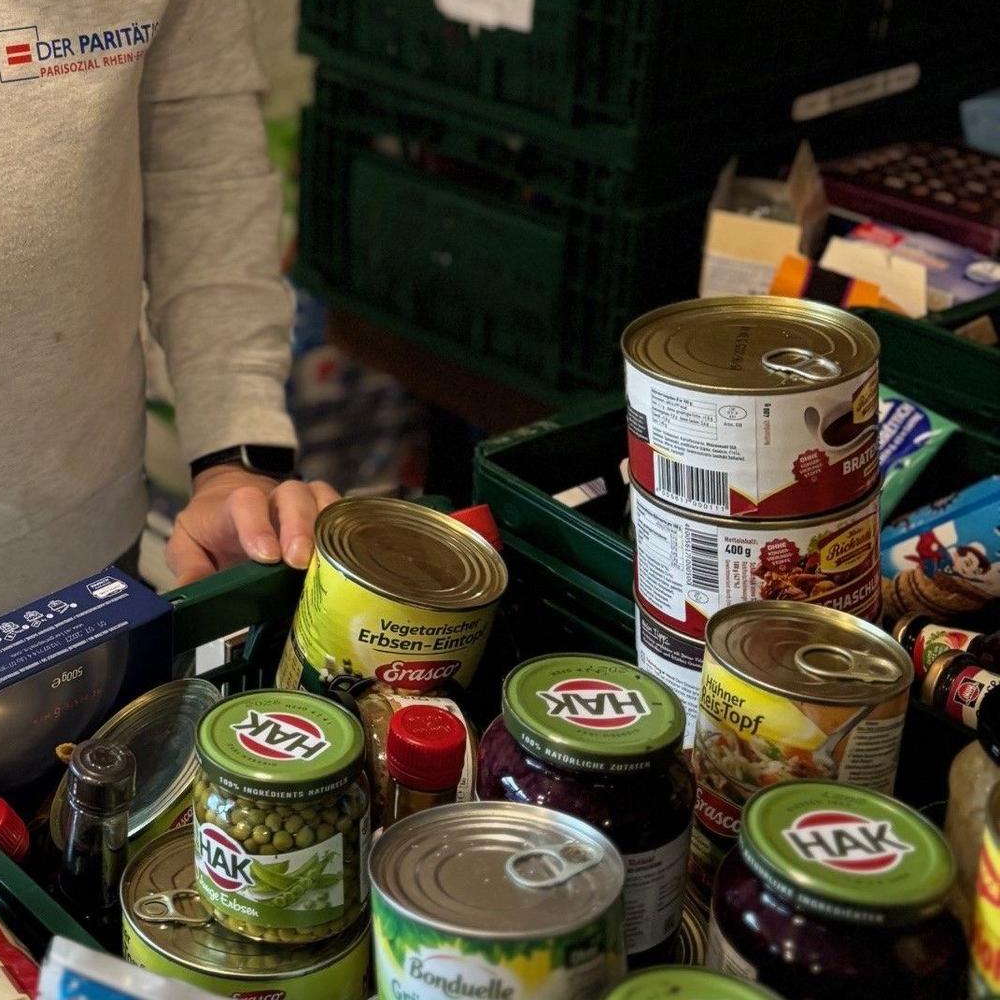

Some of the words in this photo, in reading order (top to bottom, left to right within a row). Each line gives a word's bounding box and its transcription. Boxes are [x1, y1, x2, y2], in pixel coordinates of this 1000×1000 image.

[36, 38, 77, 61] DER
[40, 60, 100, 78] PARISOZIAL
[725, 544, 743, 556] 400
[744, 548, 752, 558] g
[380, 618, 481, 636] Vegetarischer
[383, 661, 456, 682] Erasco
[539, 691, 646, 716] HAK
[705, 675, 746, 706] Hühner
[701, 685, 765, 735] Reis-Topf
[233, 711, 327, 759] HAK
[520, 733, 542, 750] 100%
[545, 748, 606, 769] NATÜRLICHE
[219, 776, 240, 790] 100%
[243, 785, 304, 798] INGRÉDIENTS
[308, 777, 348, 796] NATURELS
[788, 824, 913, 859] HAK
[200, 839, 255, 885] HAK
[219, 892, 259, 918] Erbsen
[408, 956, 515, 1000] Bonduelle
